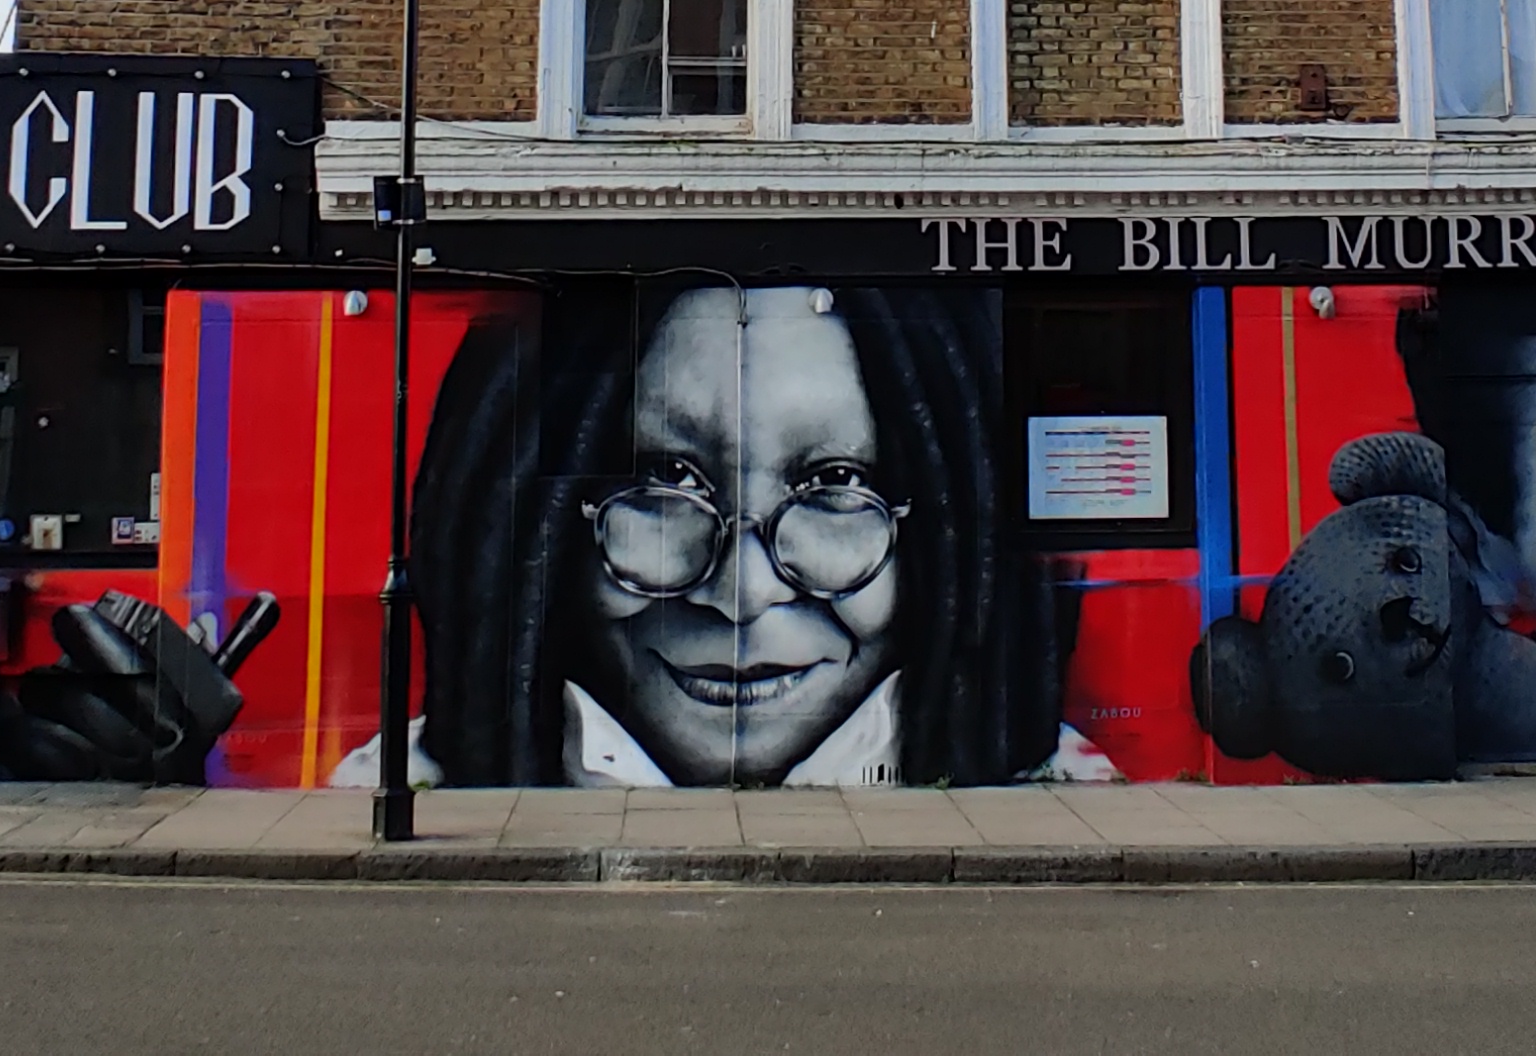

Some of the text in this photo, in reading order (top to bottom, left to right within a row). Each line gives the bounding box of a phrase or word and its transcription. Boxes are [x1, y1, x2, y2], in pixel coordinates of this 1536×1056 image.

[9, 90, 254, 230] CLUB
[921, 217, 1072, 271] THE
[1117, 217, 1276, 271] BILL
[1090, 707, 1142, 720] ZABOU
